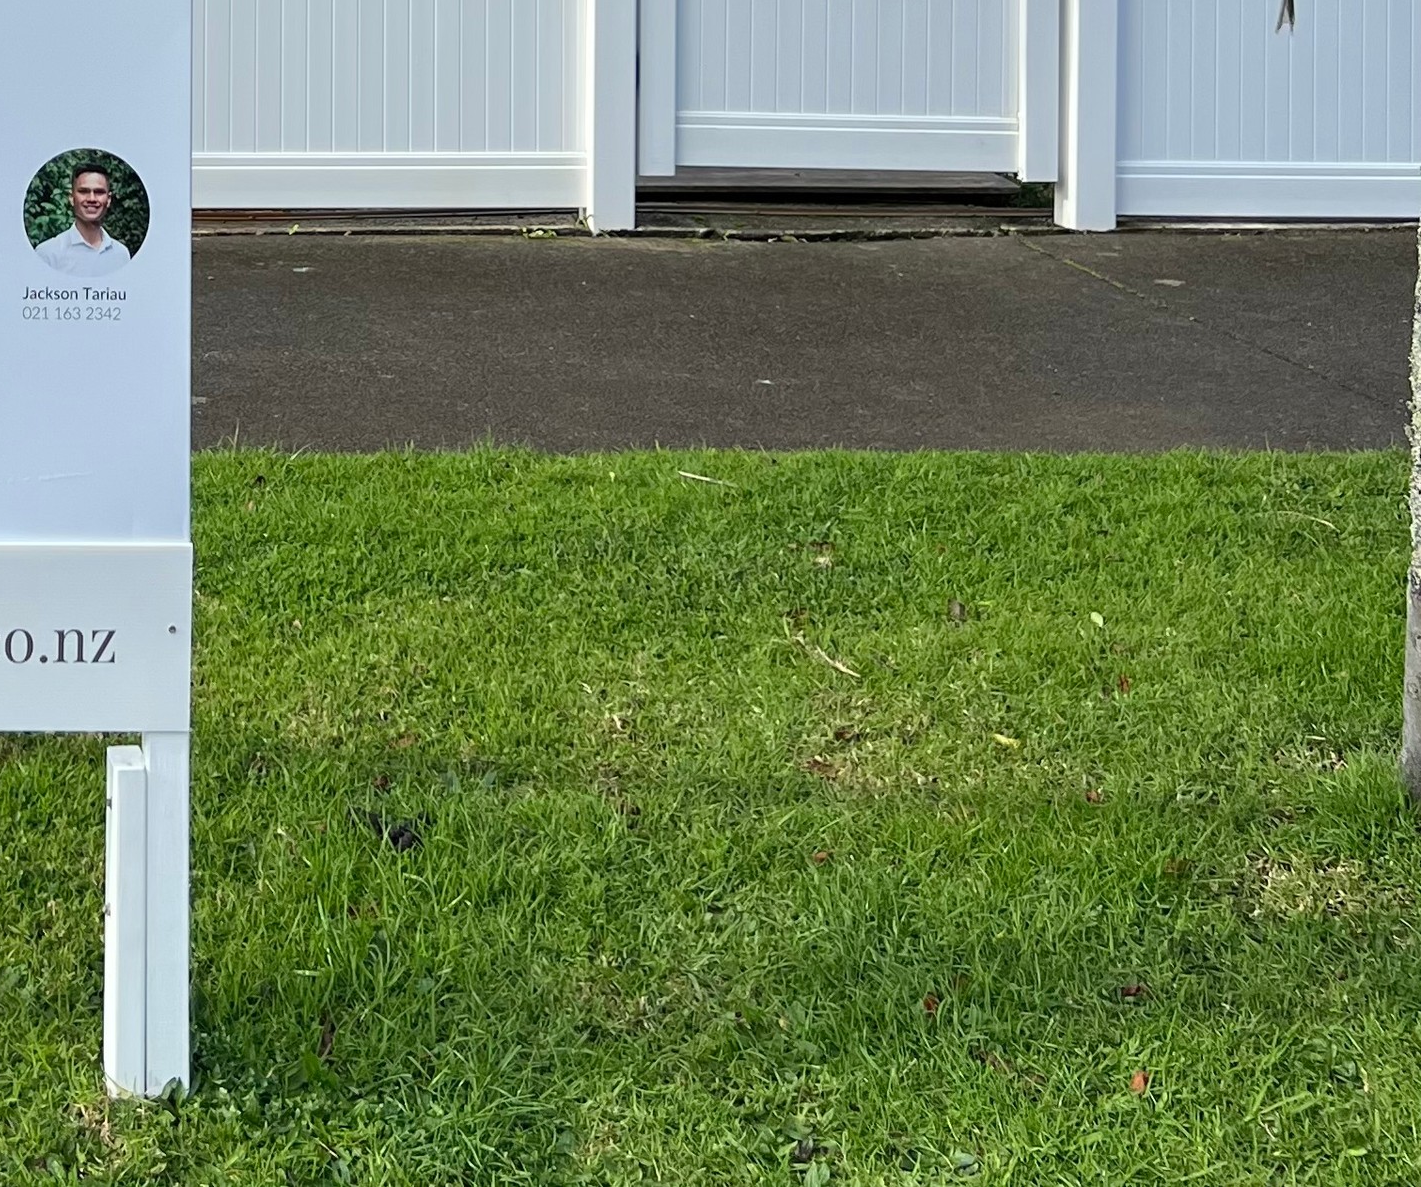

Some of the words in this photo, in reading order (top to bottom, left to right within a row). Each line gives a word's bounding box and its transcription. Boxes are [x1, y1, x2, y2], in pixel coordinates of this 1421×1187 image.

[22, 286, 79, 301] Jackson
[82, 286, 127, 301] Tariau
[22, 305, 49, 320] 021
[55, 306, 82, 321] 163
[85, 306, 122, 321] 2342
